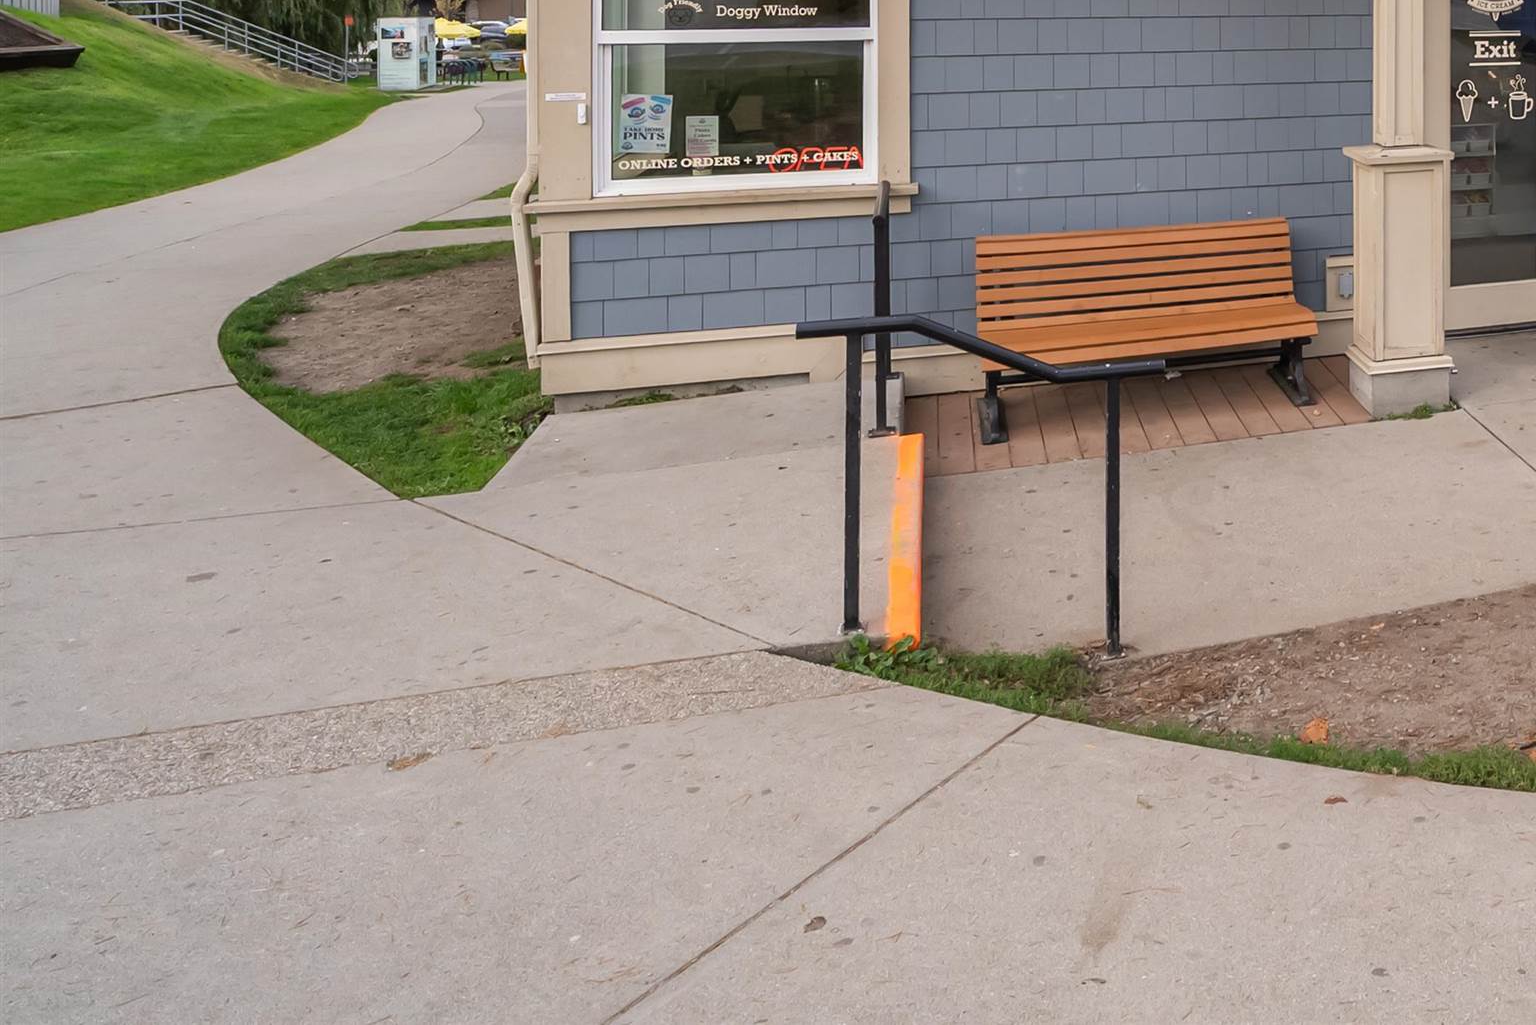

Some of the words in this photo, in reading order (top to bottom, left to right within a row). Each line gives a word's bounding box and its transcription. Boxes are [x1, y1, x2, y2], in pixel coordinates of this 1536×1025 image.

[657, 1, 673, 14] Dog
[1490, 0, 1515, 10] CREAM
[716, 5, 761, 19] Doggy
[763, 5, 818, 17] Window
[1474, 40, 1516, 58] Exit
[624, 132, 665, 140] PINTS
[618, 158, 678, 171] ONLINE
[680, 156, 740, 168] ORDERS
[744, 156, 753, 165] +
[755, 153, 798, 165] PINTS
[812, 151, 858, 163] CAKES
